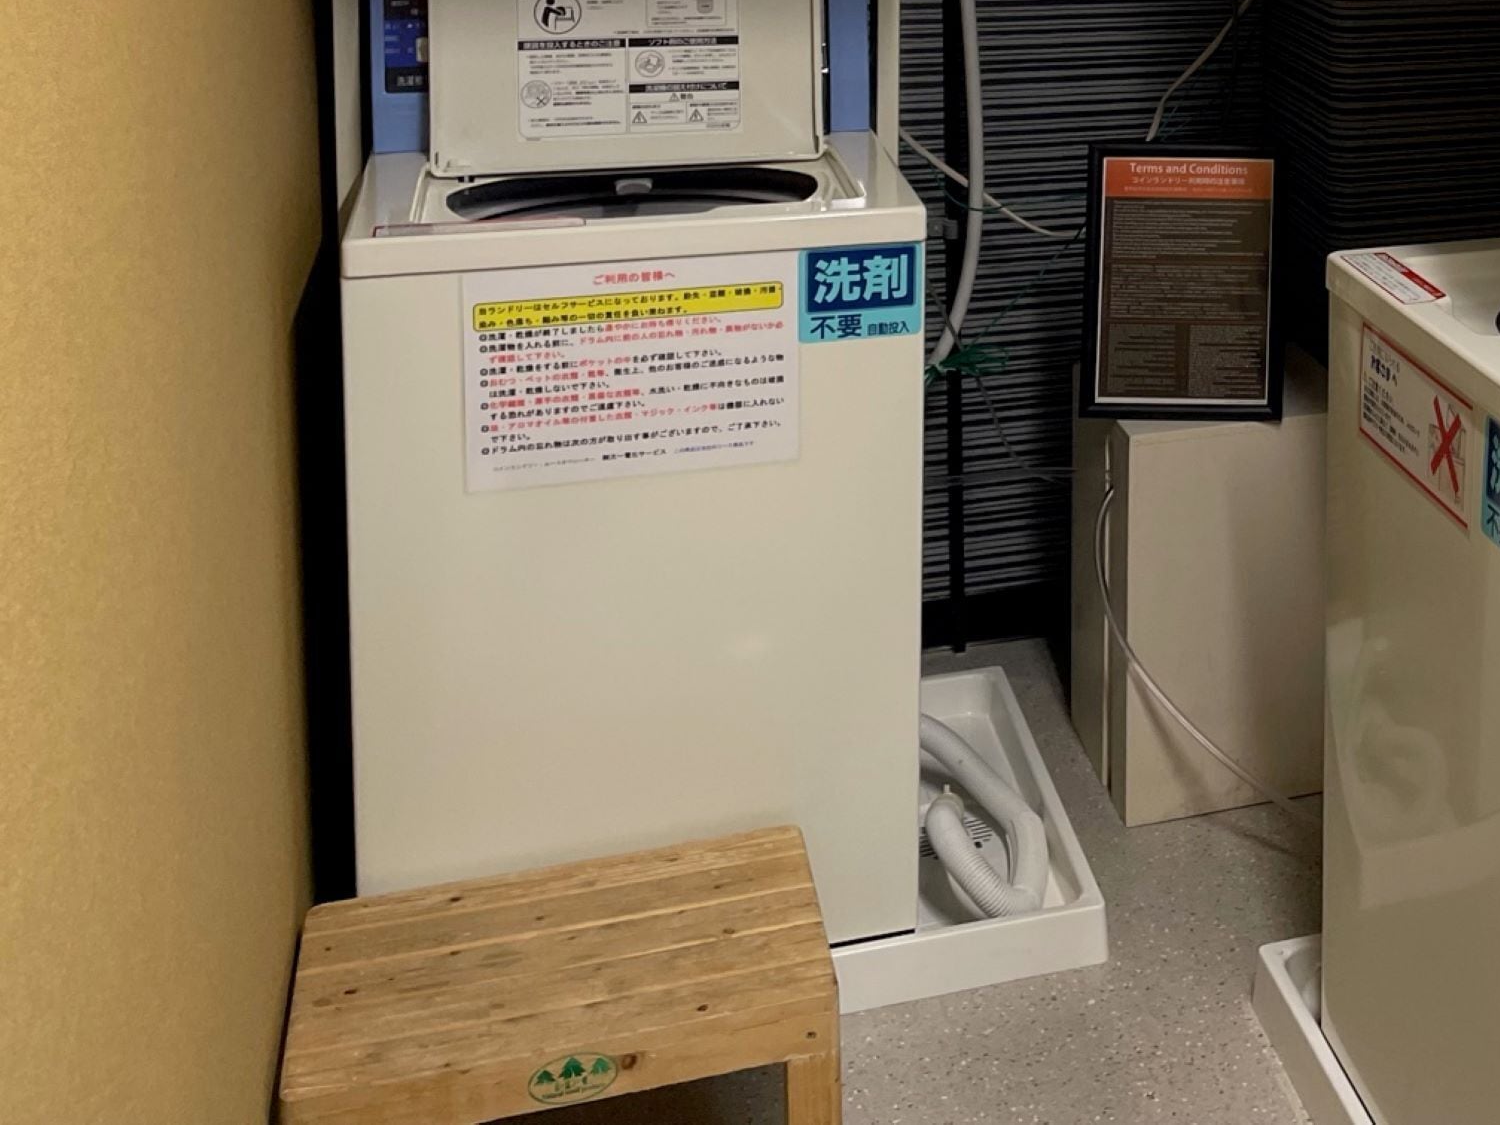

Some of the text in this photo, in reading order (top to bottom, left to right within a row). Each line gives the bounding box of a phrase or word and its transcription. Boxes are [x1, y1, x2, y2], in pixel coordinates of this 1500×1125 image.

[1130, 162, 1249, 176] Terms and Conditions
[592, 270, 676, 286] ご利用の皆様へ
[813, 254, 909, 305] 洗剤
[810, 314, 862, 340] 不要
